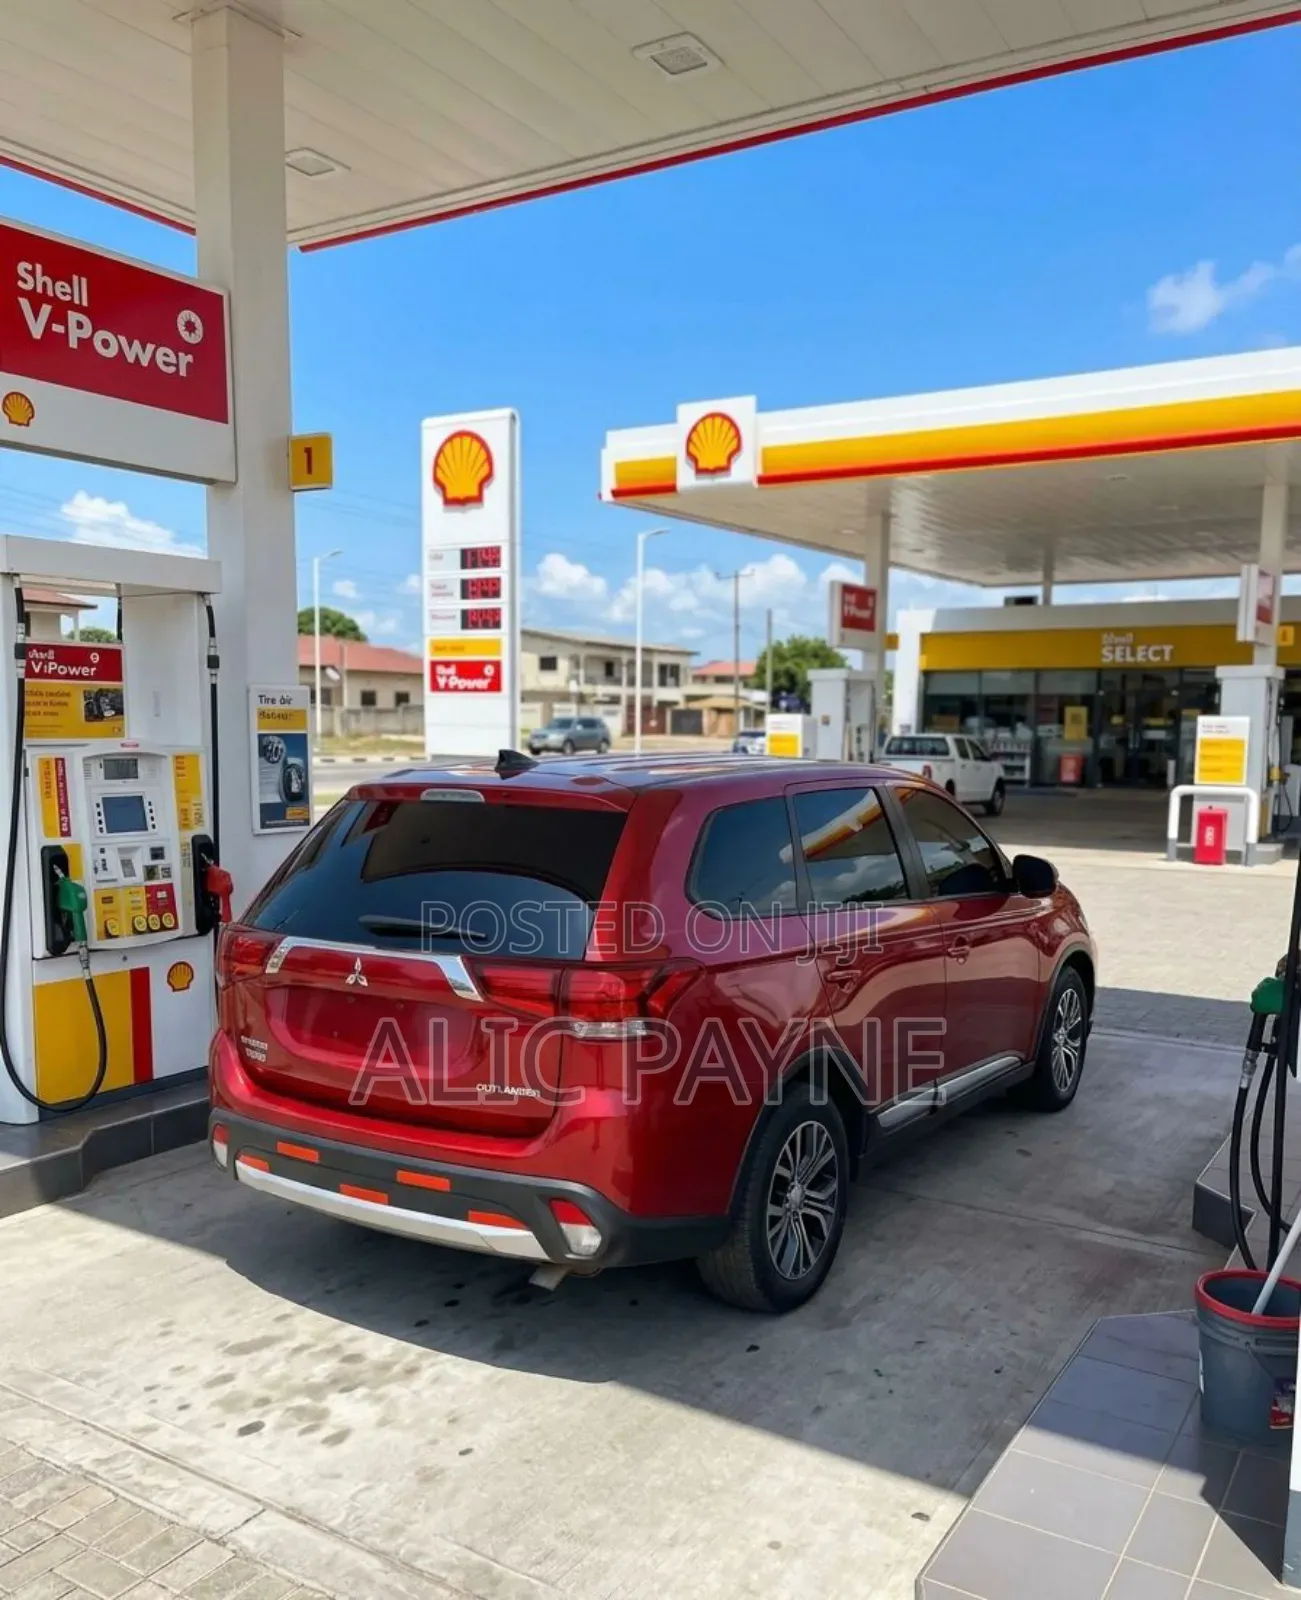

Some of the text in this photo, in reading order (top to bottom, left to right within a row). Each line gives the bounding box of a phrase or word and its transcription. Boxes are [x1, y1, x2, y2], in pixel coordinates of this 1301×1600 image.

[16, 261, 88, 307] Shell
[18, 297, 194, 377] V-Power
[303, 446, 313, 476] 1
[1101, 644, 1174, 663] SELECT
[258, 694, 277, 705] Tire
